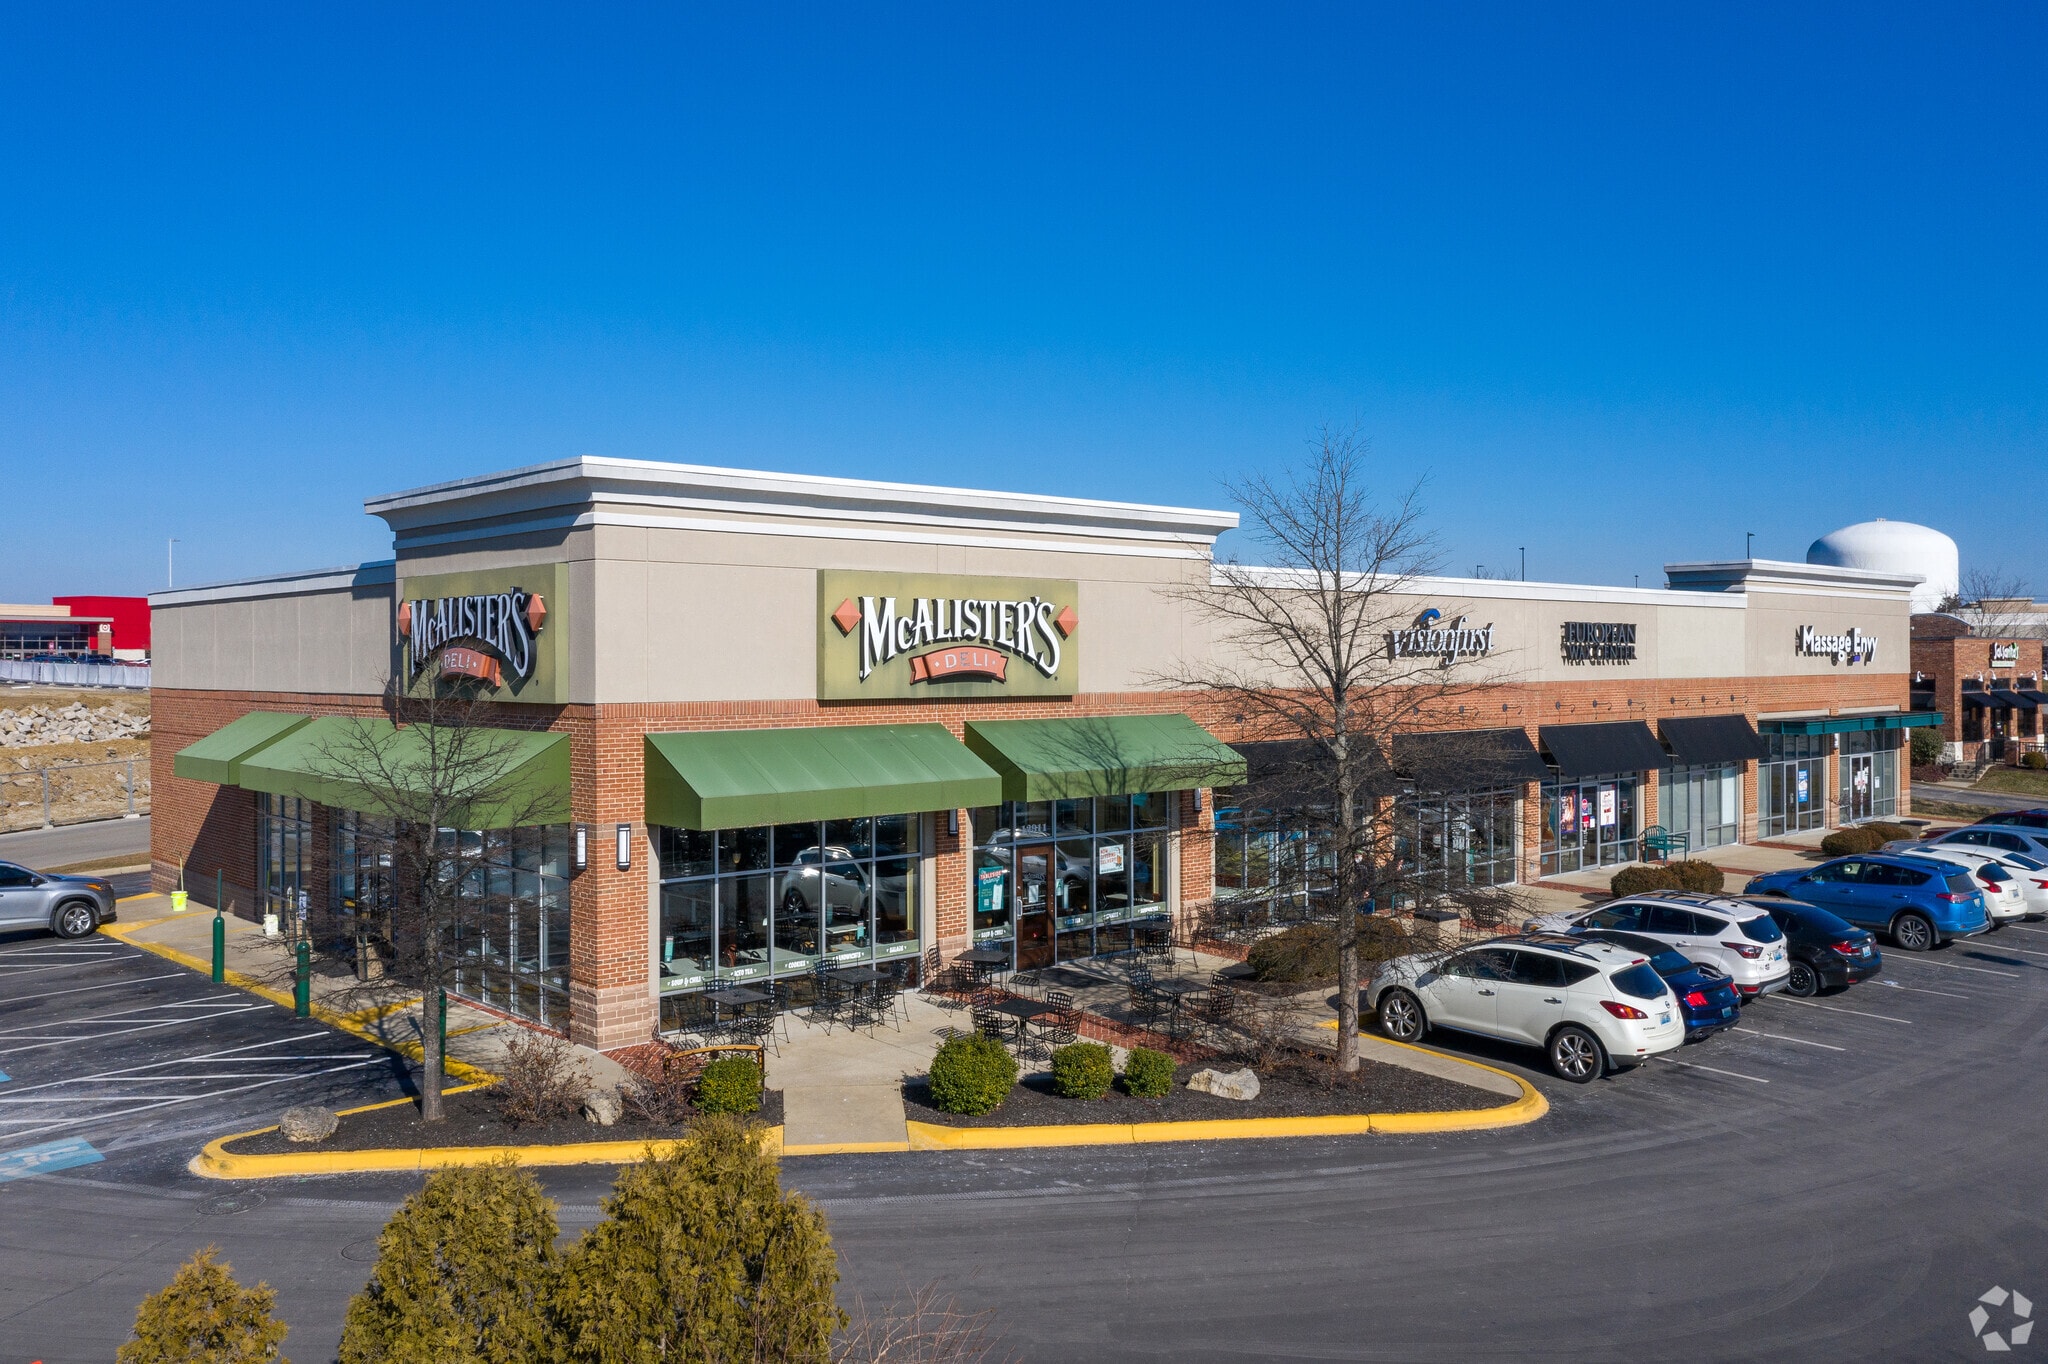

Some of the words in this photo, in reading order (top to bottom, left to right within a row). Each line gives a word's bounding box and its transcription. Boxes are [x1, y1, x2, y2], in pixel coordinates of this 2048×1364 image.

[411, 587, 529, 678] McALISTER'S
[859, 596, 1061, 679] McALISTER'S
[1567, 622, 1637, 643] EUROPEAN
[1567, 645, 1592, 660] WAX
[1595, 645, 1637, 660] CENTER
[1802, 625, 1851, 662] Massage
[1853, 627, 1878, 662] Envy
[444, 651, 471, 669] DELI
[945, 652, 989, 669] DELI
